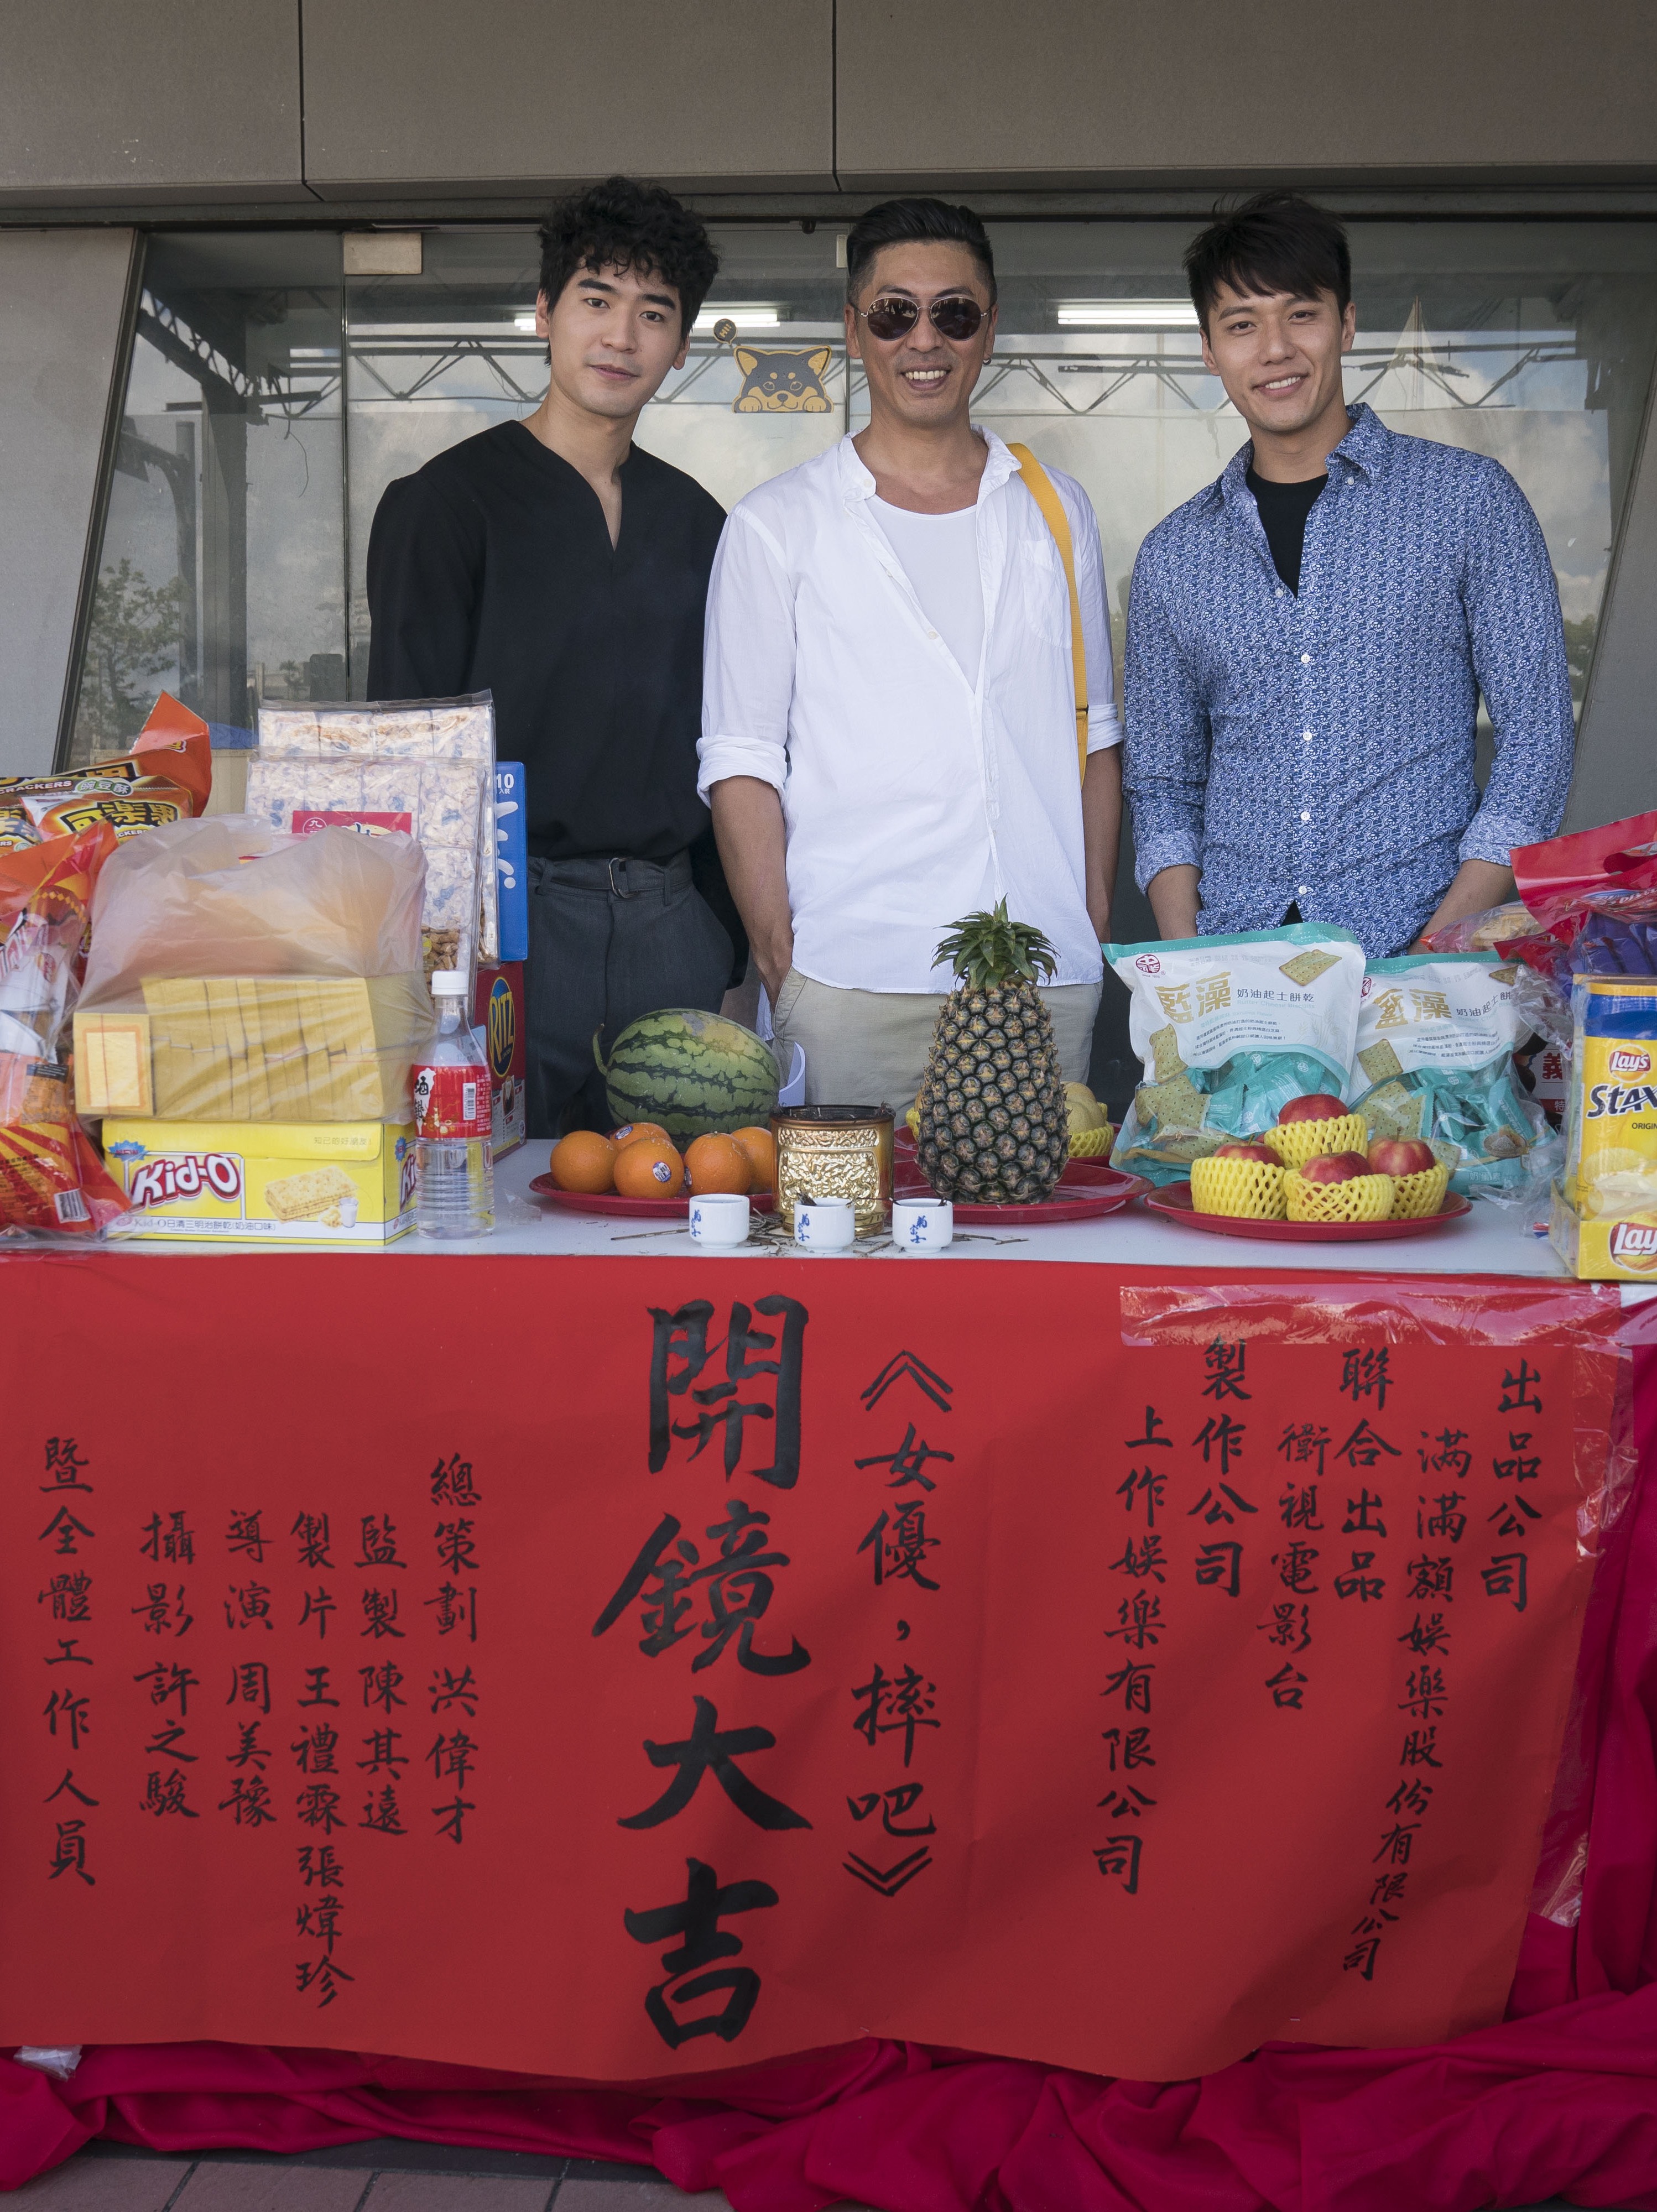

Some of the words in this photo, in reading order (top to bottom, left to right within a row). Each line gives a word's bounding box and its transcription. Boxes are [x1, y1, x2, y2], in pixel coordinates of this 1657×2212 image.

[0, 780, 72, 795] CRACKERS
[496, 774, 514, 789] 10
[117, 830, 148, 838] CKER
[1154, 971, 1231, 1024] 藍藻
[1237, 988, 1315, 1003] 奶油起士餅乾
[1456, 991, 1511, 1016] 奶油起士餅
[488, 992, 514, 1068] RITZ
[1611, 1052, 1649, 1072] Lay's
[129, 1154, 240, 1211] Kid-O
[1613, 1223, 1657, 1255] Lay
[1187, 1333, 1258, 1598] 製作公司
[1334, 1347, 1402, 1602] 聯合出品
[1481, 1358, 1543, 1612] 出品公司
[1257, 1423, 1331, 1710] 衛視電影台
[38, 1437, 100, 1886] 暨全體工作人員
[592, 1295, 812, 2049] 開鏡大吉
[1093, 1405, 1173, 1895] 上作娛樂有限公司
